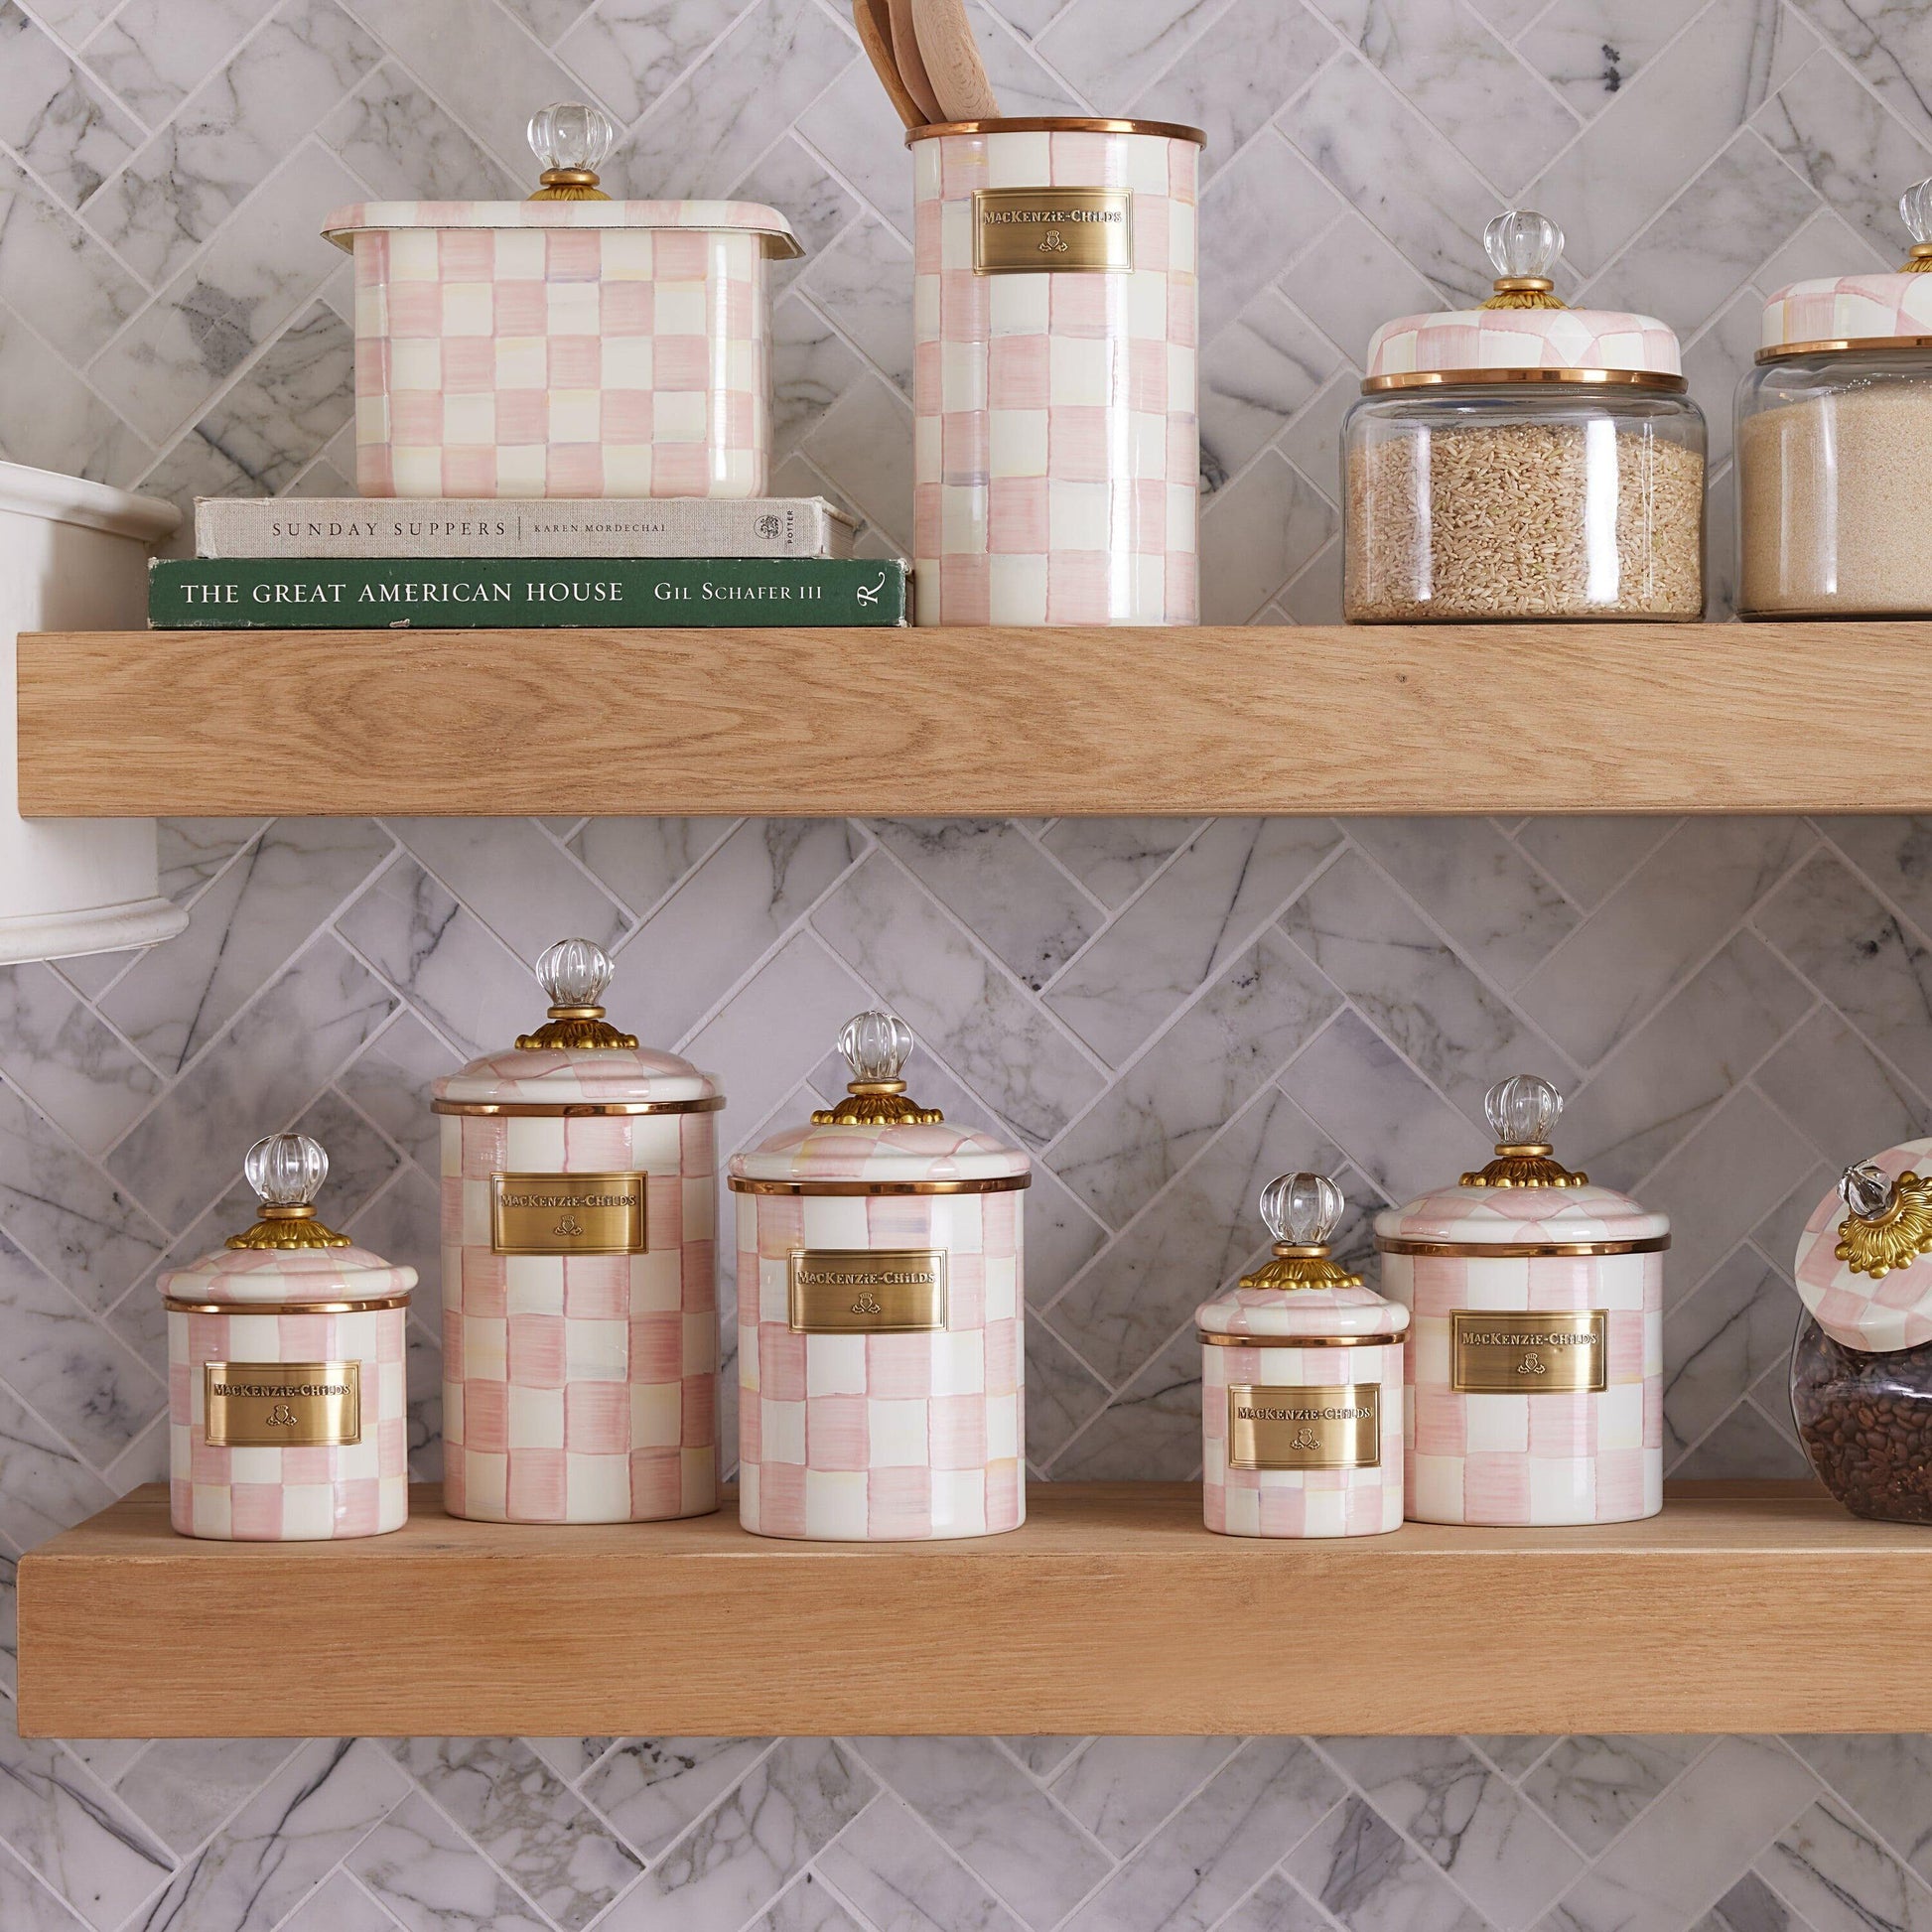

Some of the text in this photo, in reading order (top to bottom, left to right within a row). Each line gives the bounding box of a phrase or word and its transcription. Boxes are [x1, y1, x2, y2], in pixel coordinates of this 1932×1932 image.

[272, 522, 506, 536] SUNDAY SUPPERS
[534, 524, 666, 533] KAREN MORDECHAI
[181, 582, 623, 604] THE GREAT AMERICAN HOUSE
[800, 586, 822, 600] III
